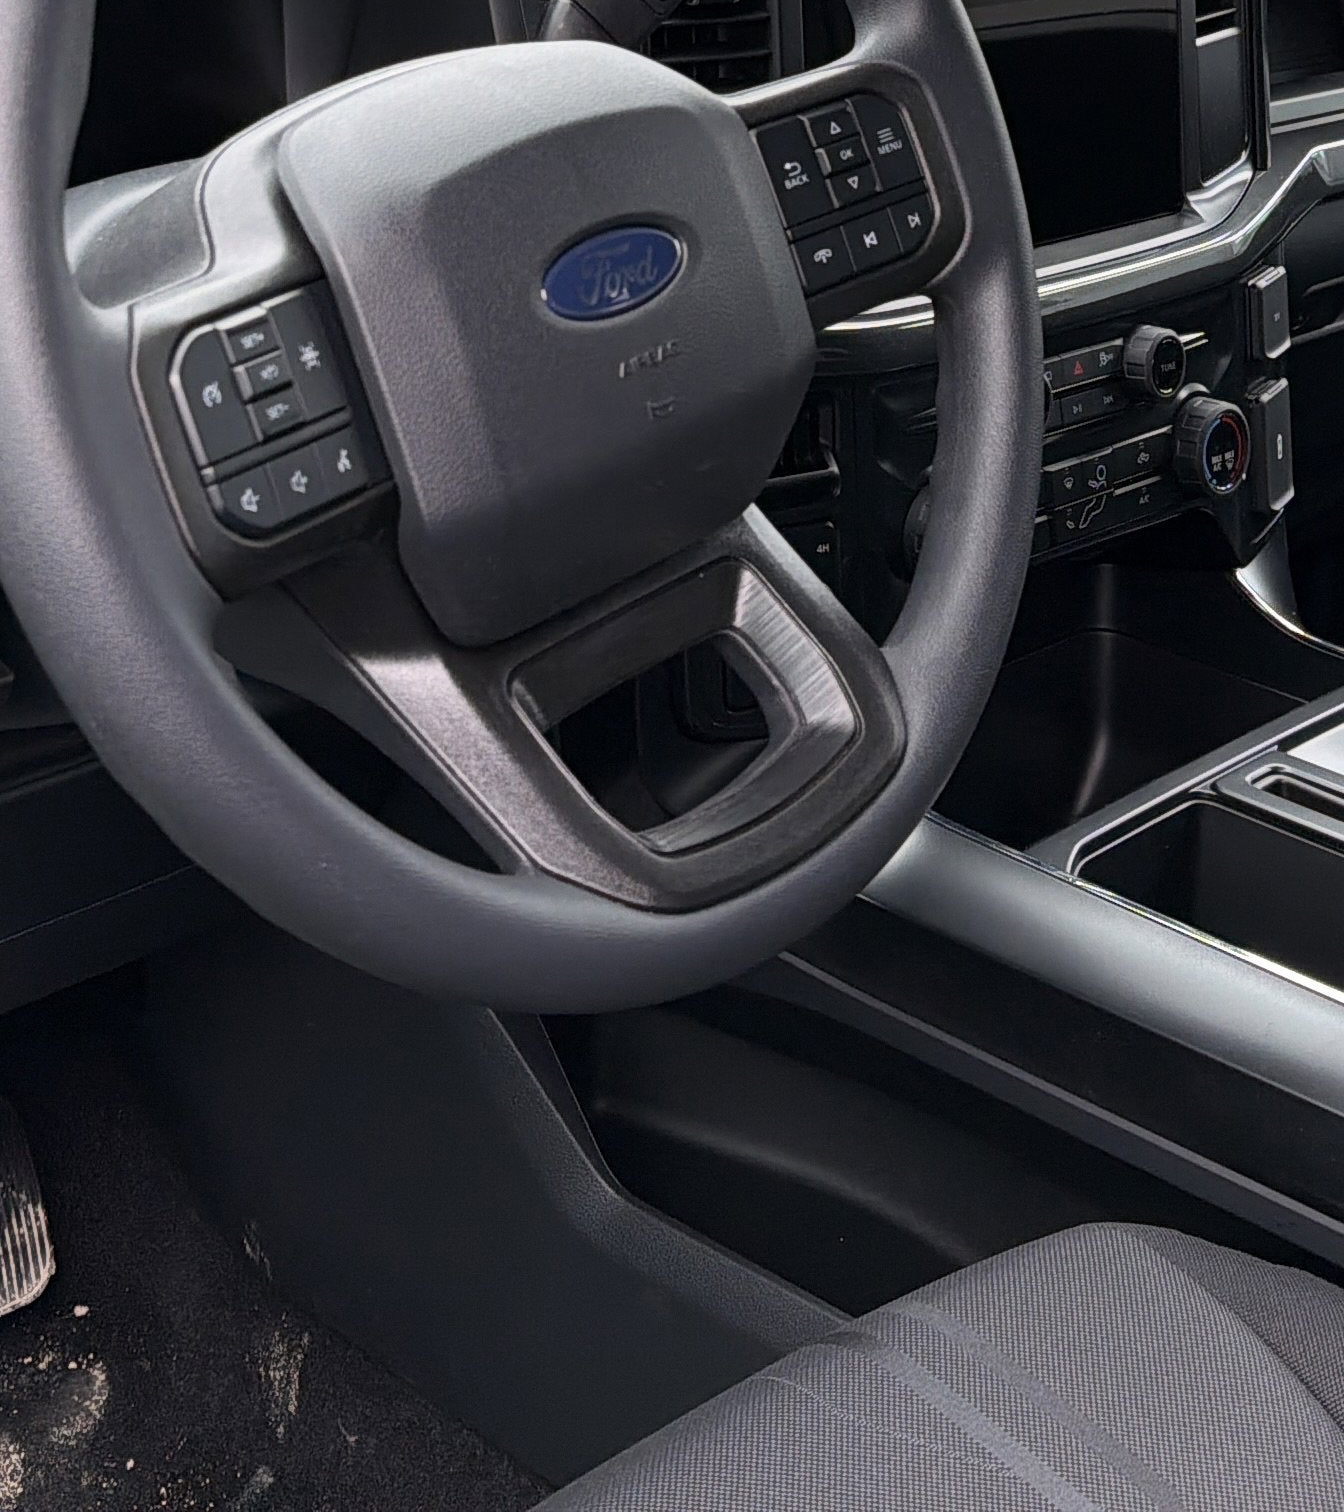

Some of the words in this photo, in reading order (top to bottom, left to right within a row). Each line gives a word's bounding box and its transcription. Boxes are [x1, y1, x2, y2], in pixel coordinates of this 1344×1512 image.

[839, 148, 853, 161] OK
[878, 140, 903, 155] MENU
[784, 175, 810, 190] BACK
[579, 241, 661, 308] Ford
[816, 543, 830, 553] 4H
